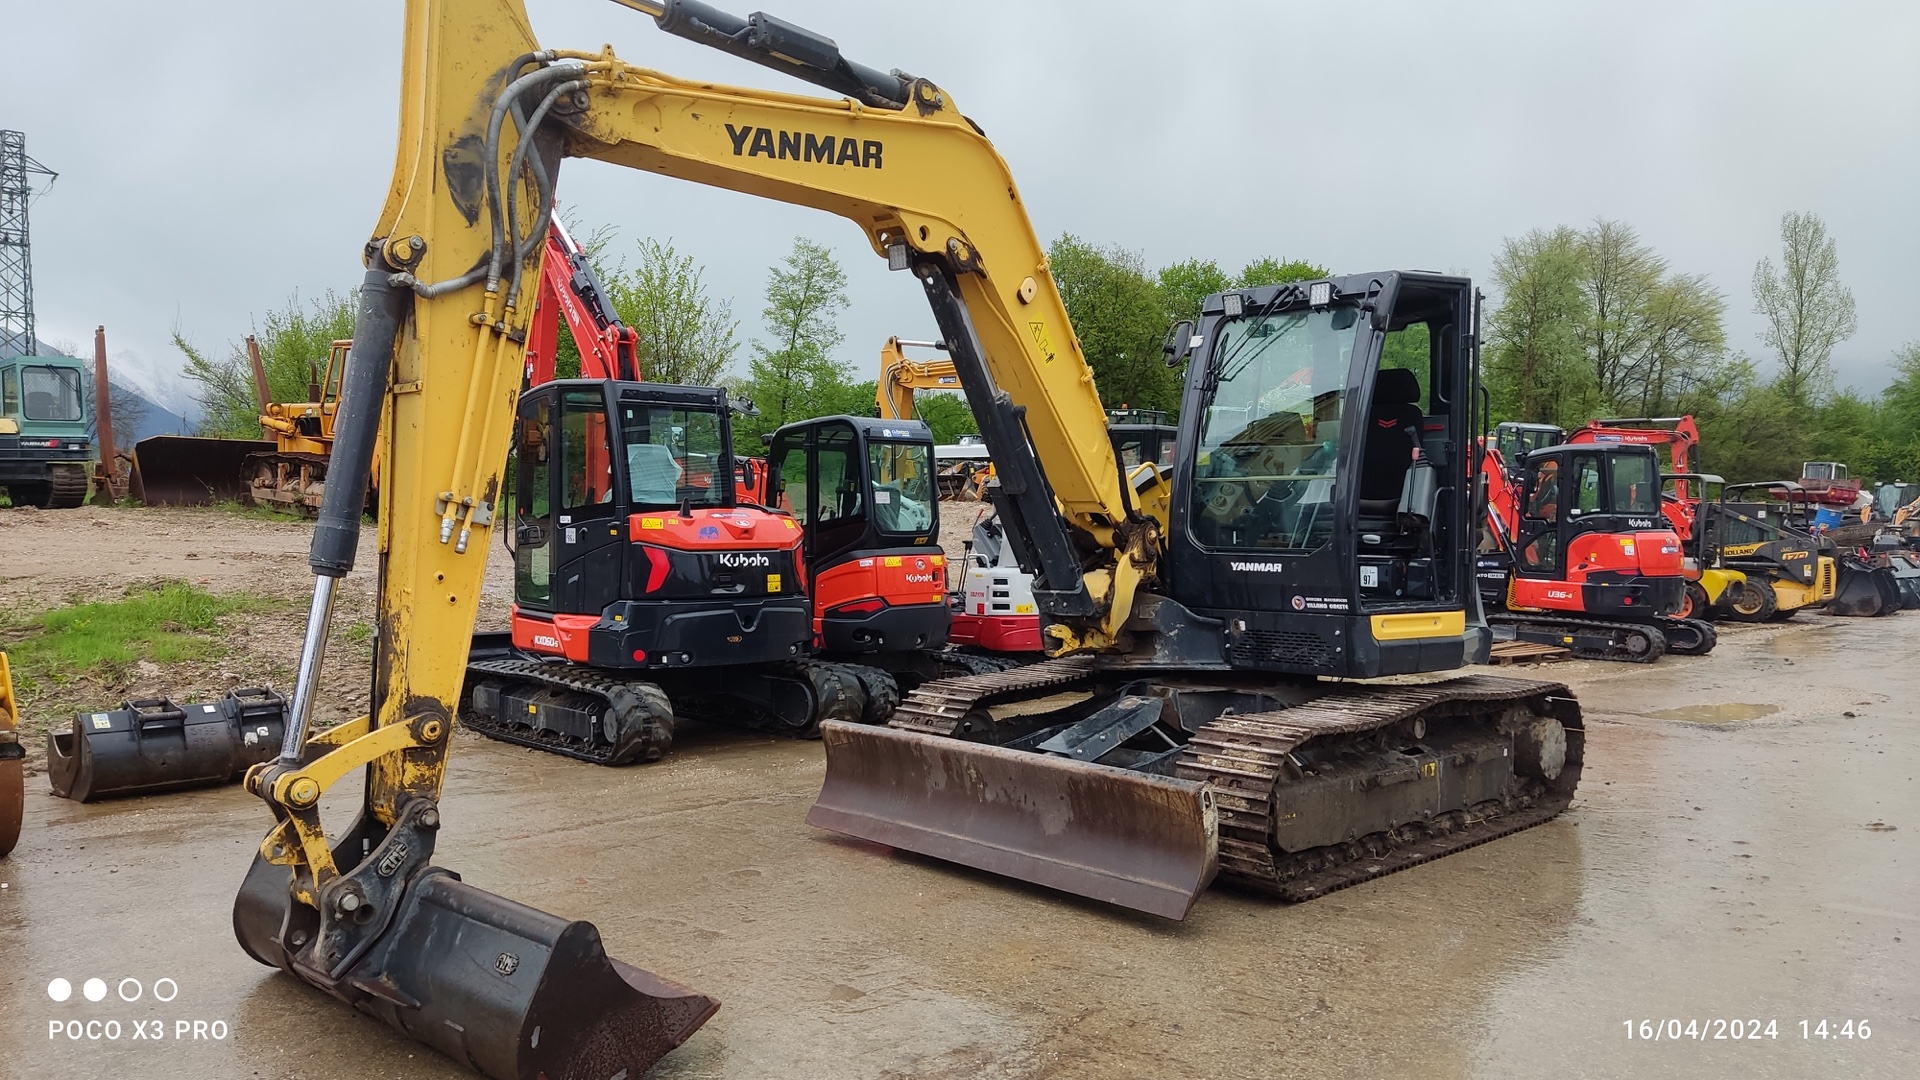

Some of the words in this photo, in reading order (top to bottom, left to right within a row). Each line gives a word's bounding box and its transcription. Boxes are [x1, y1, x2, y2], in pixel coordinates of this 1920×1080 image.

[724, 123, 883, 170] YANMAR
[1628, 518, 1652, 528] Kubota
[719, 553, 769, 567] Kubota
[1230, 562, 1283, 572] YANMAR
[905, 573, 933, 583] Kubota
[1363, 574, 1371, 585] 97
[1547, 590, 1573, 599] U36-4
